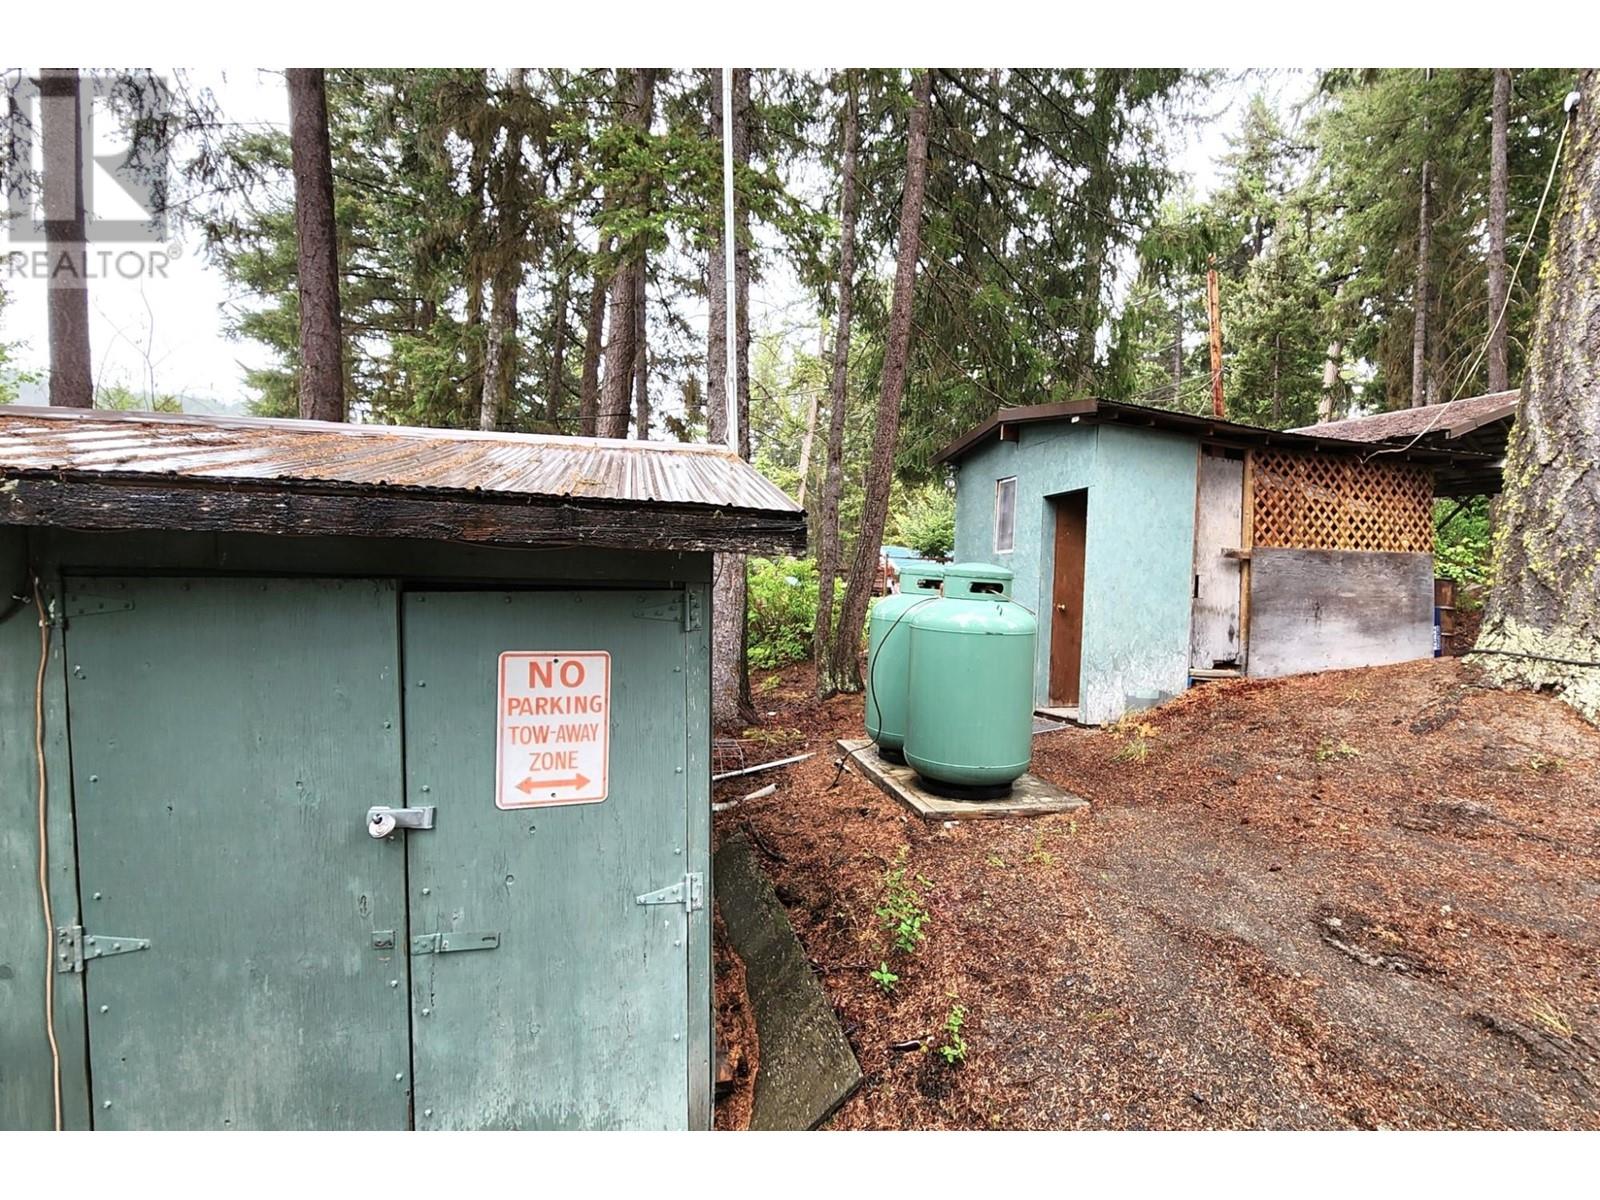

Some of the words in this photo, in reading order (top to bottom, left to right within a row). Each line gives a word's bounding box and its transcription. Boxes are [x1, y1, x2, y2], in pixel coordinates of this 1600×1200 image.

[529, 661, 585, 688] NO
[508, 696, 602, 716] PARKING
[508, 723, 599, 745] TOW-AWAY
[529, 751, 578, 771] ZONE
